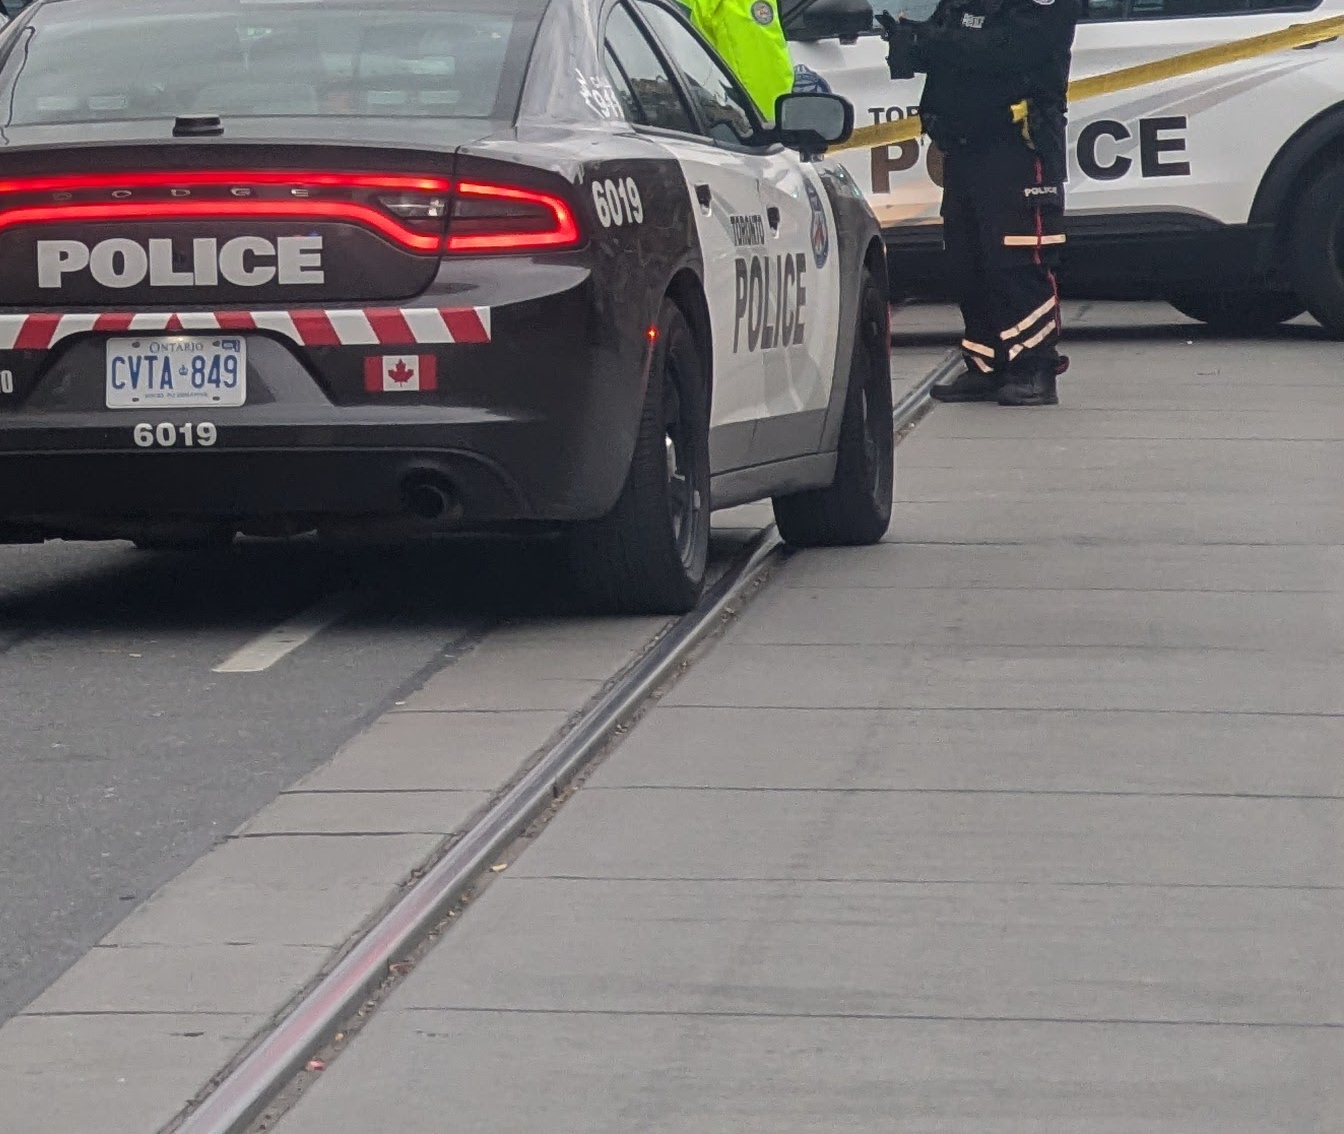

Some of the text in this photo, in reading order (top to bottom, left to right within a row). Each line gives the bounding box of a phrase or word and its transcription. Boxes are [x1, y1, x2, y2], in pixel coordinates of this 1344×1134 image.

[591, 176, 644, 228] 6019
[37, 235, 325, 288] POLICE
[733, 253, 807, 354] POLICE
[149, 341, 204, 354] ONTARIO
[111, 353, 238, 390] CVTA 849
[133, 421, 218, 448] 6019
